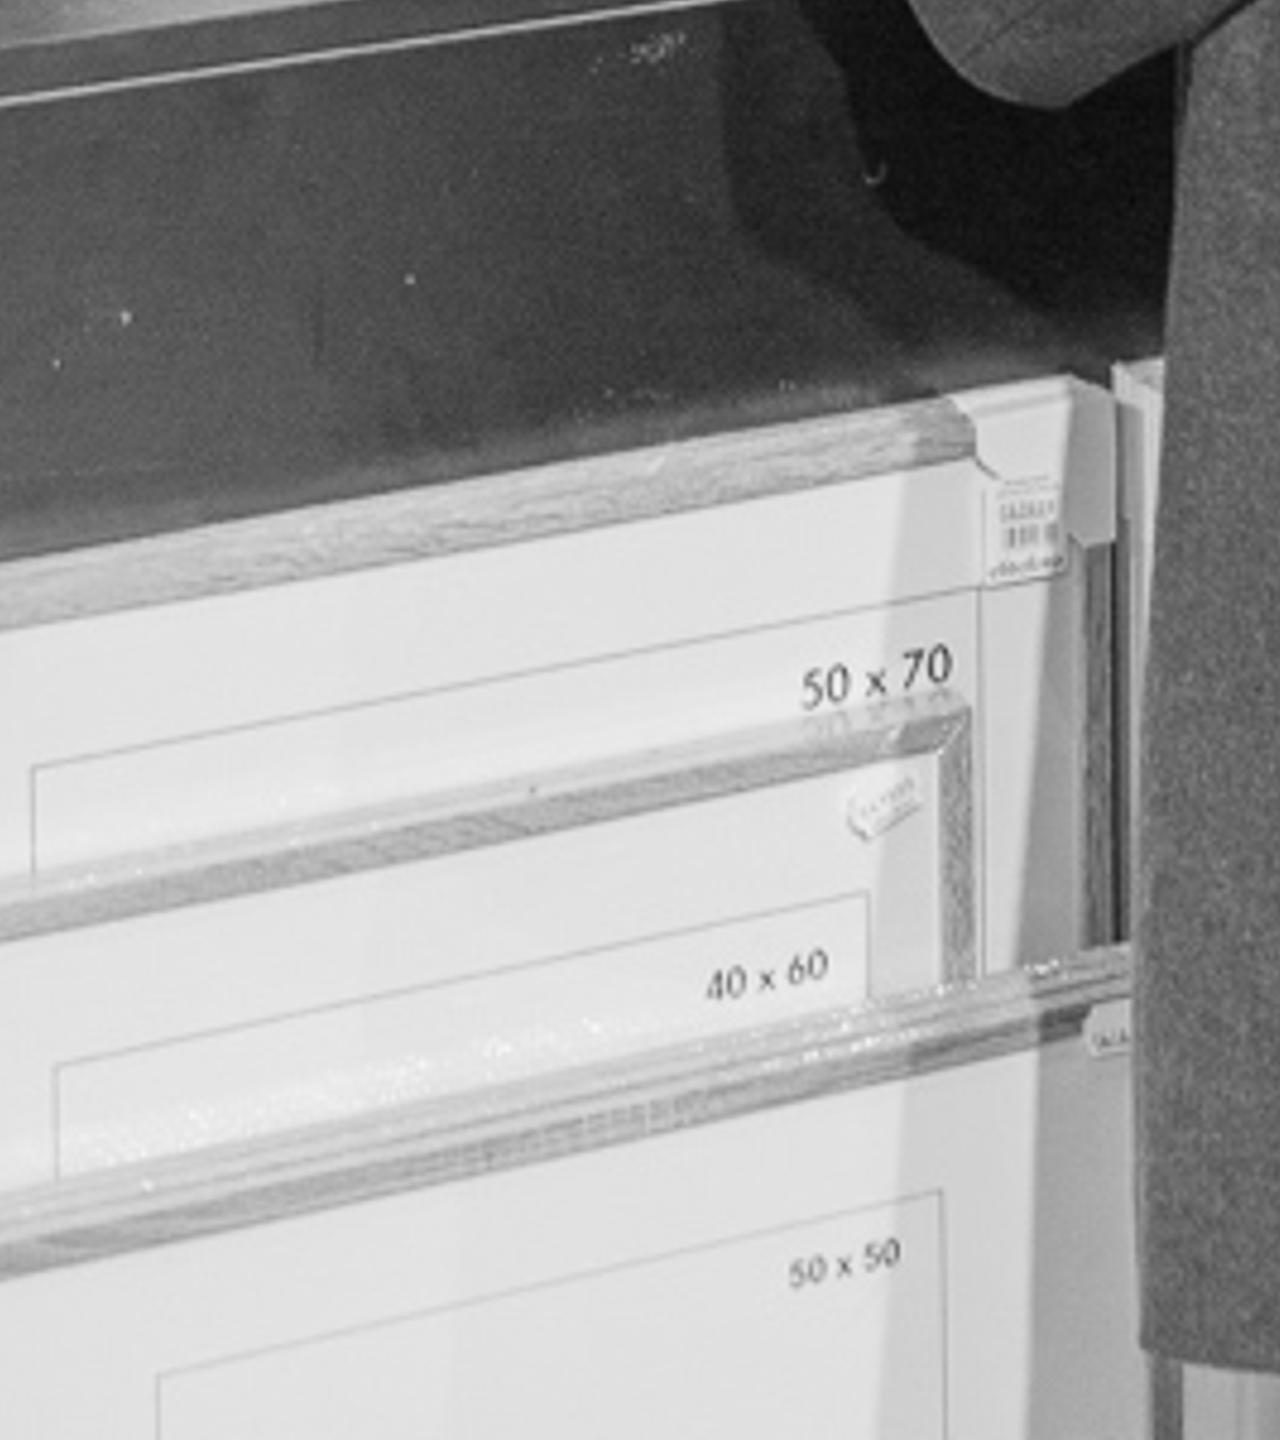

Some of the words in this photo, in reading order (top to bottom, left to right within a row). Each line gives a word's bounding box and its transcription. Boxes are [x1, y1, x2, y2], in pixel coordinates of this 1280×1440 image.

[802, 662, 852, 711] 50
[866, 668, 887, 697] x
[902, 642, 954, 690] 70
[706, 964, 748, 1001] 40
[786, 947, 829, 986] 60
[788, 1253, 829, 1291] 50
[864, 1236, 902, 1273] 50
